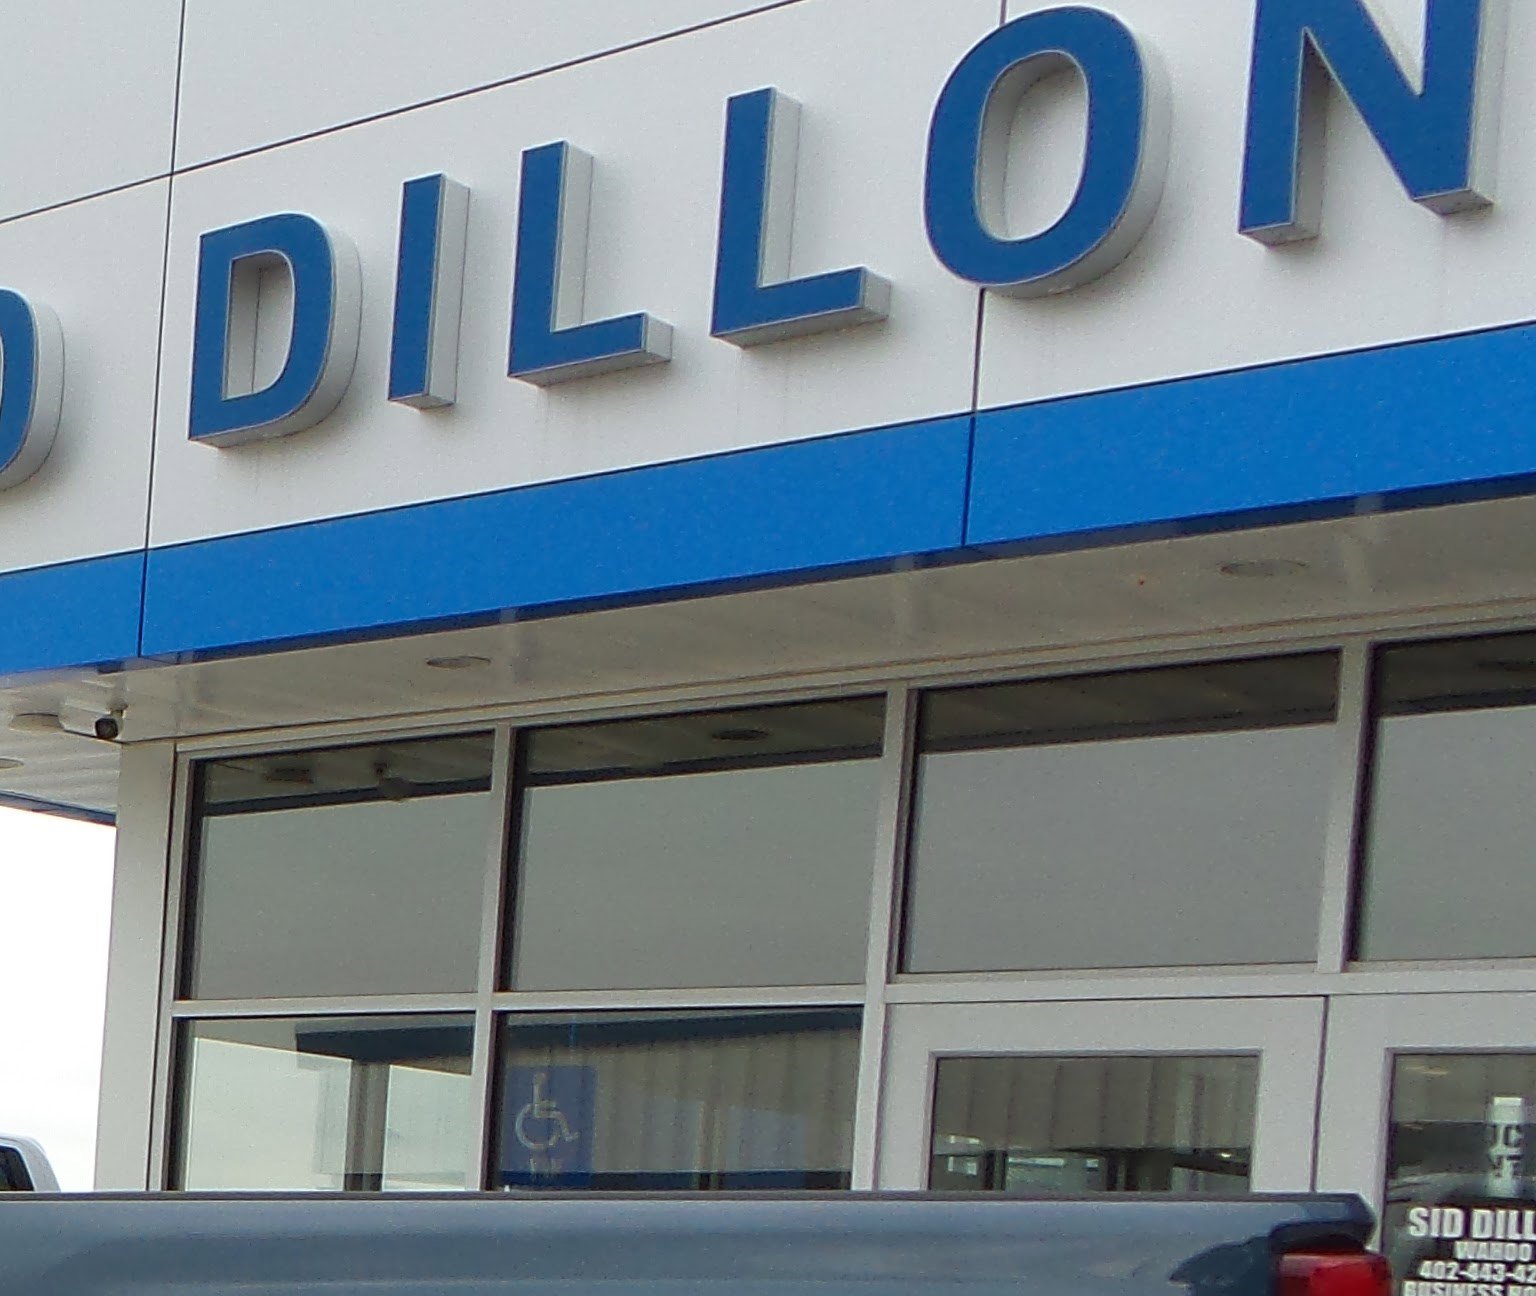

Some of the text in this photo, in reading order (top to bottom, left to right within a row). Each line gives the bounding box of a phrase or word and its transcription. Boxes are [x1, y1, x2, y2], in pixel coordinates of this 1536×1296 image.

[187, 0, 1508, 448] DILLON
[1408, 1206, 1465, 1238] SID
[1454, 1240, 1533, 1262] WAHOO
